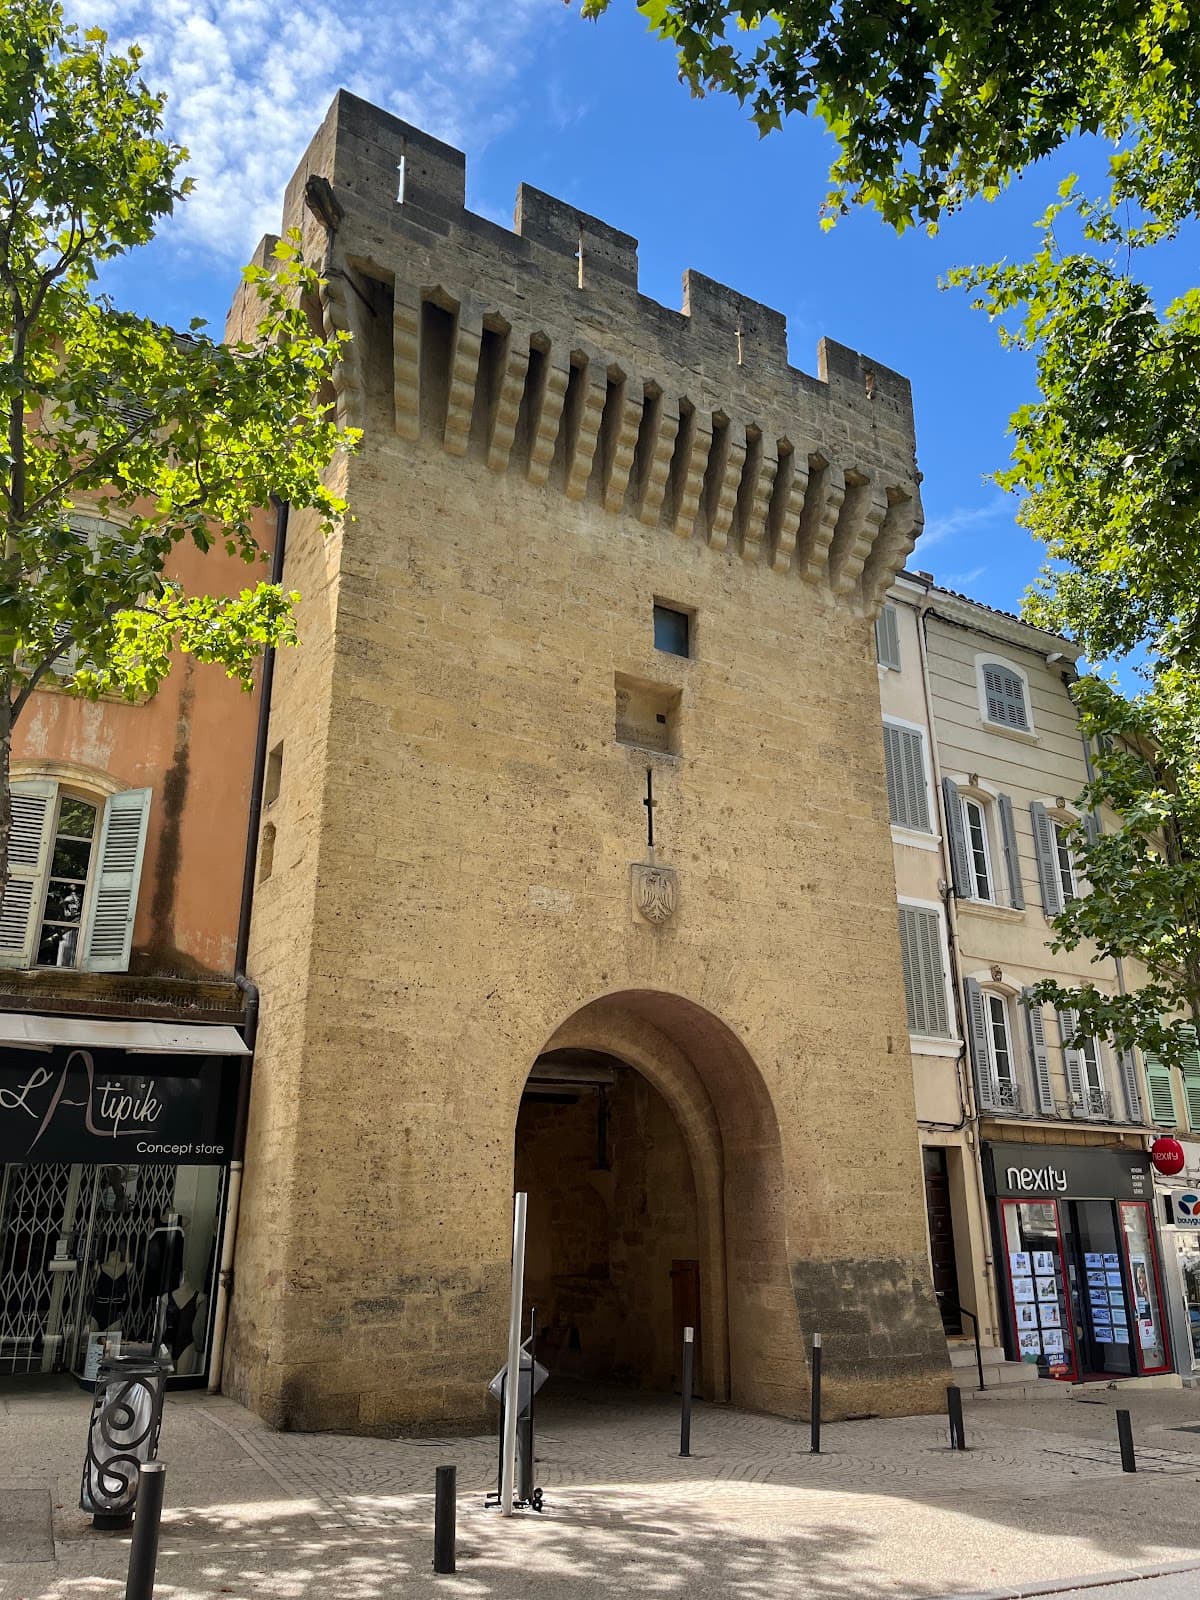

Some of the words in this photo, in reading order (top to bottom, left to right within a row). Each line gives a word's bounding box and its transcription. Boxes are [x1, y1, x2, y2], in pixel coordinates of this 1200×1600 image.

[136, 1142, 192, 1155] Concept
[195, 1143, 224, 1154] store
[1152, 1152, 1179, 1161] nexity
[1007, 1166, 1067, 1191] nexity
